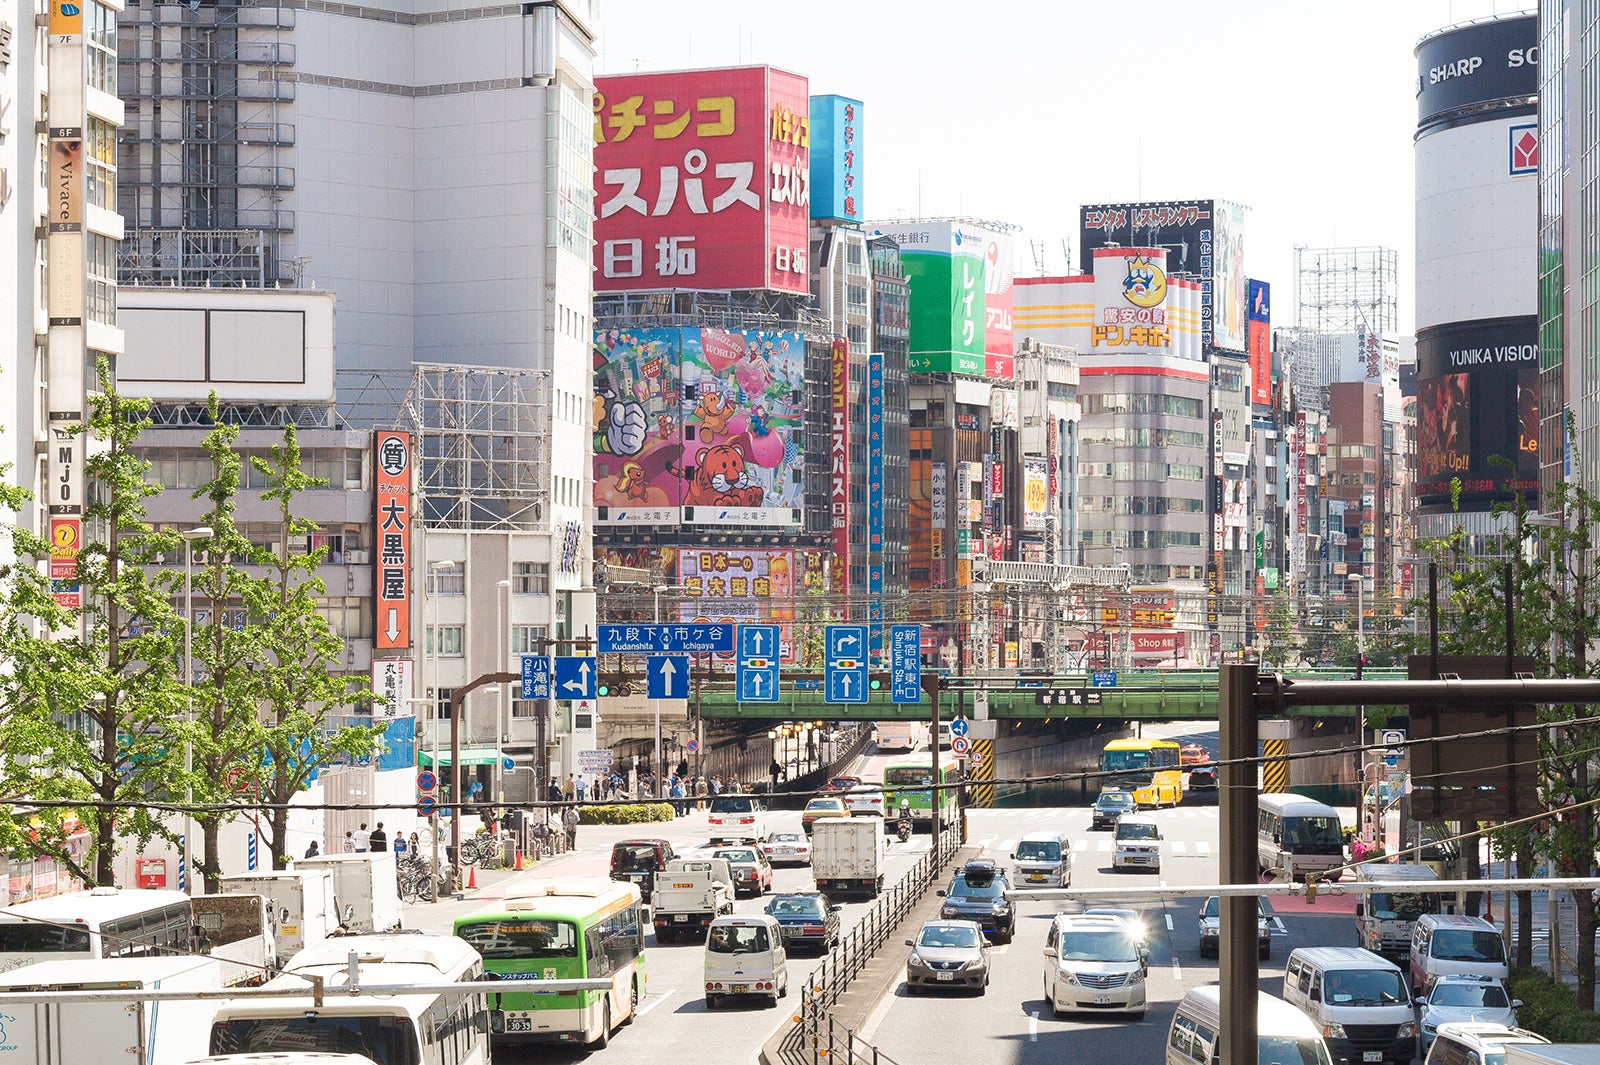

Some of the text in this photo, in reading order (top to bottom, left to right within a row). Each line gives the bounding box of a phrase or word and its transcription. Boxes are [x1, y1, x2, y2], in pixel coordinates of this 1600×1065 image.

[60, 35, 72, 44] 7F
[1429, 56, 1483, 85] SHARP
[59, 128, 73, 137] 6F
[771, 101, 809, 148] パチンコ
[844, 103, 857, 216] カラオケ館
[60, 161, 73, 220] Vivace
[594, 148, 761, 219] スパス
[770, 154, 809, 207] エスパス
[58, 224, 73, 232] 5F
[1085, 205, 1211, 229] エンタメ レストランタワー
[603, 235, 696, 278] 日拓
[775, 243, 806, 275] 日拓
[962, 262, 975, 347] レイク
[986, 307, 1012, 331] アコム
[706, 343, 737, 359] WORLD
[1449, 347, 1492, 366] YUNIKA
[994, 360, 1004, 374] 3F
[832, 347, 846, 529] パチンコ エスパス 日拓
[383, 443, 405, 471] 質
[379, 483, 407, 494] チケット
[932, 473, 941, 520] 小松ビル
[59, 505, 72, 513] 2F
[643, 511, 672, 521] 北電子
[742, 510, 768, 521] 北電子
[381, 498, 405, 601] 大黒屋
[52, 567, 76, 576] 銀行AT
[701, 552, 753, 572] 日本一の
[608, 627, 657, 641] 九段下
[663, 634, 669, 642] 4
[611, 641, 714, 651] Kudanshita Ichigaya
[1138, 637, 1160, 649] Shop
[895, 631, 904, 667] Shinjuku
[904, 629, 917, 699] 新宿駅東口
[384, 662, 397, 717] 丸亀製麺
[533, 658, 548, 697] 小滝橋
[1042, 695, 1082, 704] 新宿駅
